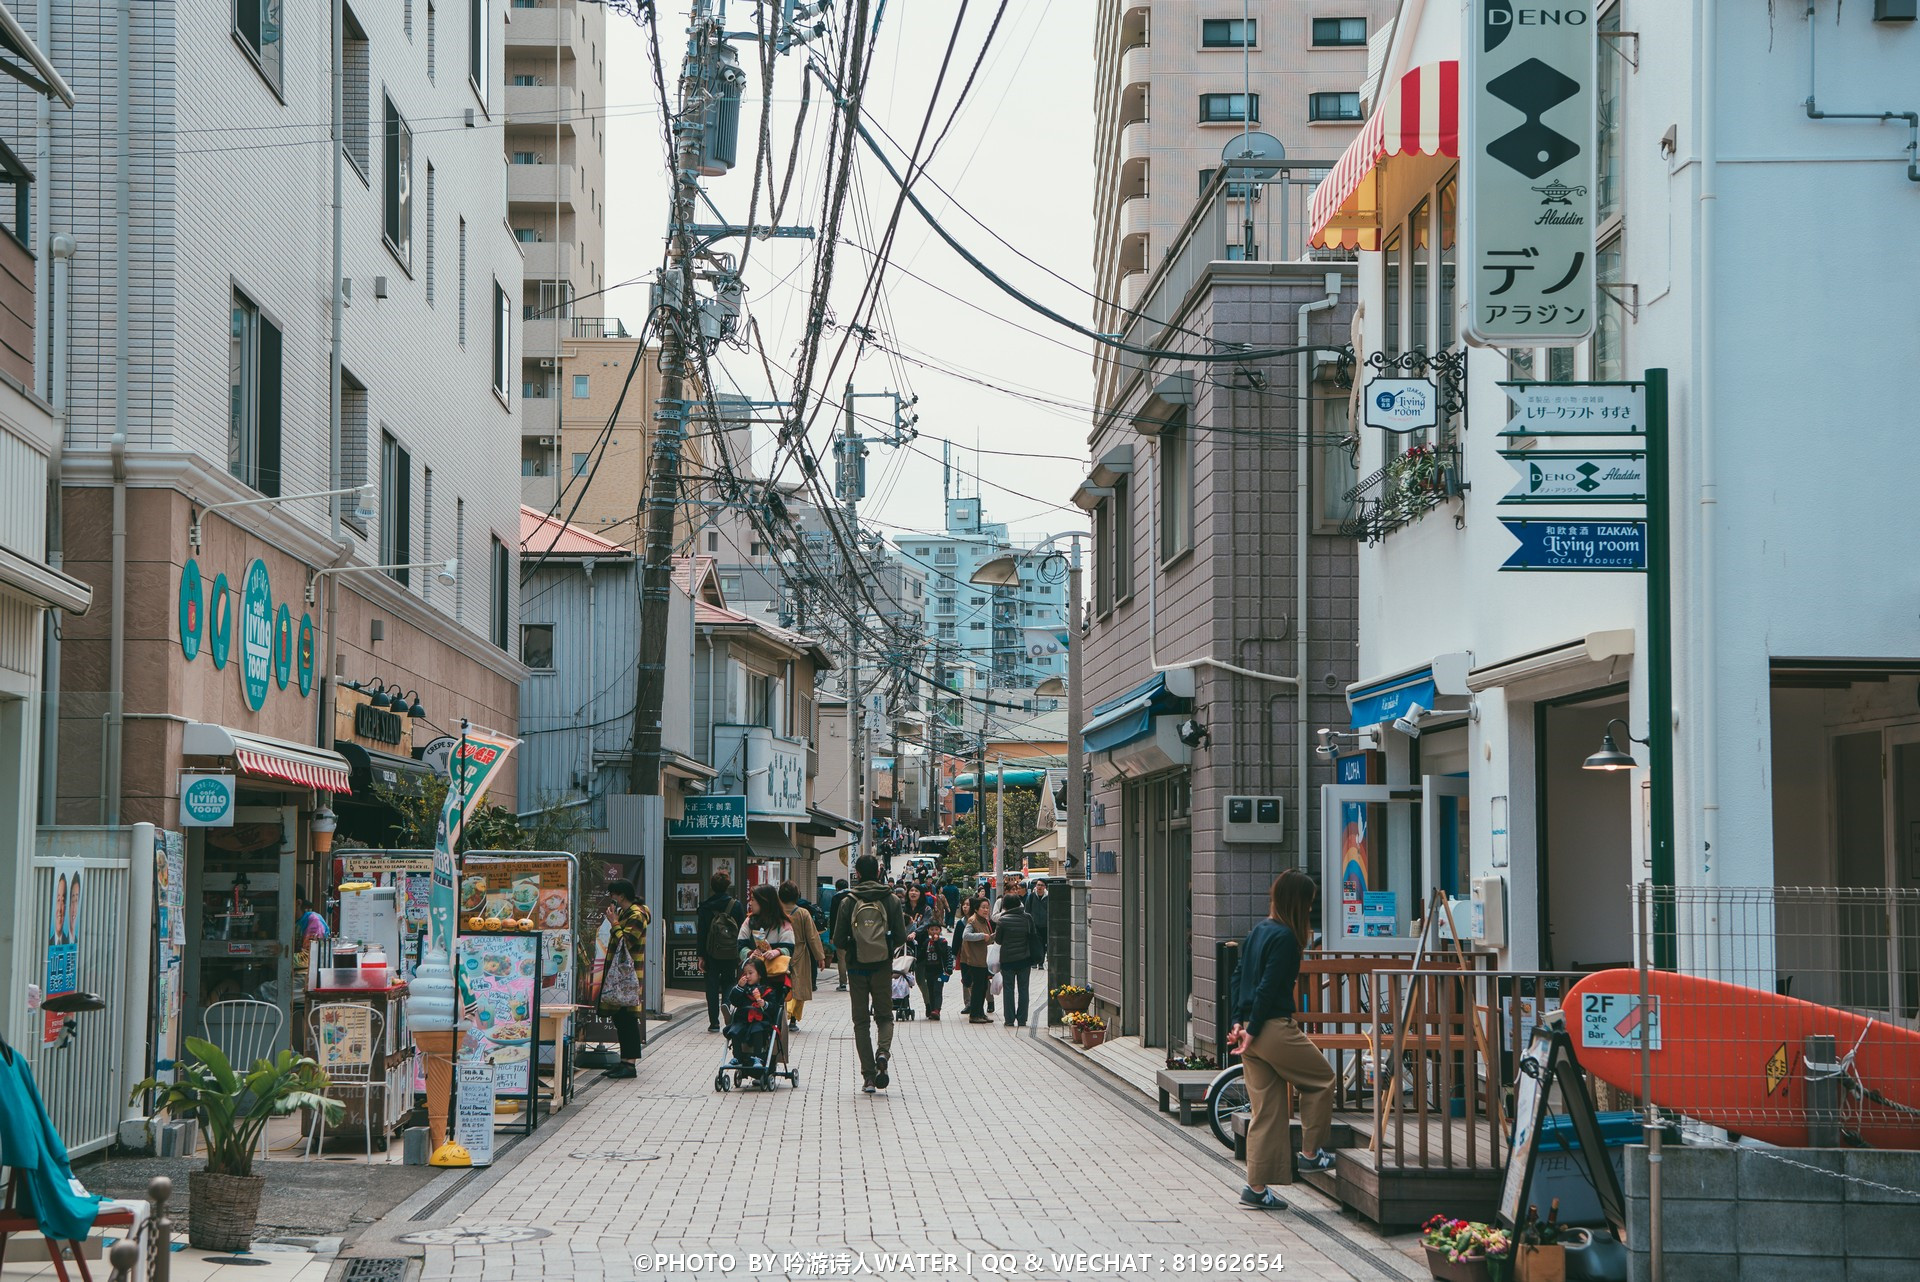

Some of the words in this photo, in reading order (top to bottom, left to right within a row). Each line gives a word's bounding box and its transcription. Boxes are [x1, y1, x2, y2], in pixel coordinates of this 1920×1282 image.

[1488, 9, 1587, 26] DENO
[1534, 208, 1584, 226] Aladdin
[1483, 246, 1585, 296] デノ
[1485, 304, 1585, 324] アラジン
[1396, 396, 1426, 410] Living
[1528, 406, 1594, 419] レザークラフト
[1600, 406, 1630, 419] すずき
[1532, 473, 1576, 482] DENO
[1602, 467, 1641, 480] Aladdin
[1597, 526, 1639, 536] IZAKAYA
[1543, 536, 1594, 558] Living
[1598, 541, 1640, 552] room
[248, 657, 268, 682] room
[427, 742, 446, 754] CREPE
[676, 814, 744, 828] 片瀬写真館
[1586, 995, 1614, 1013] 2F
[1586, 1014, 1608, 1023] Cafe
